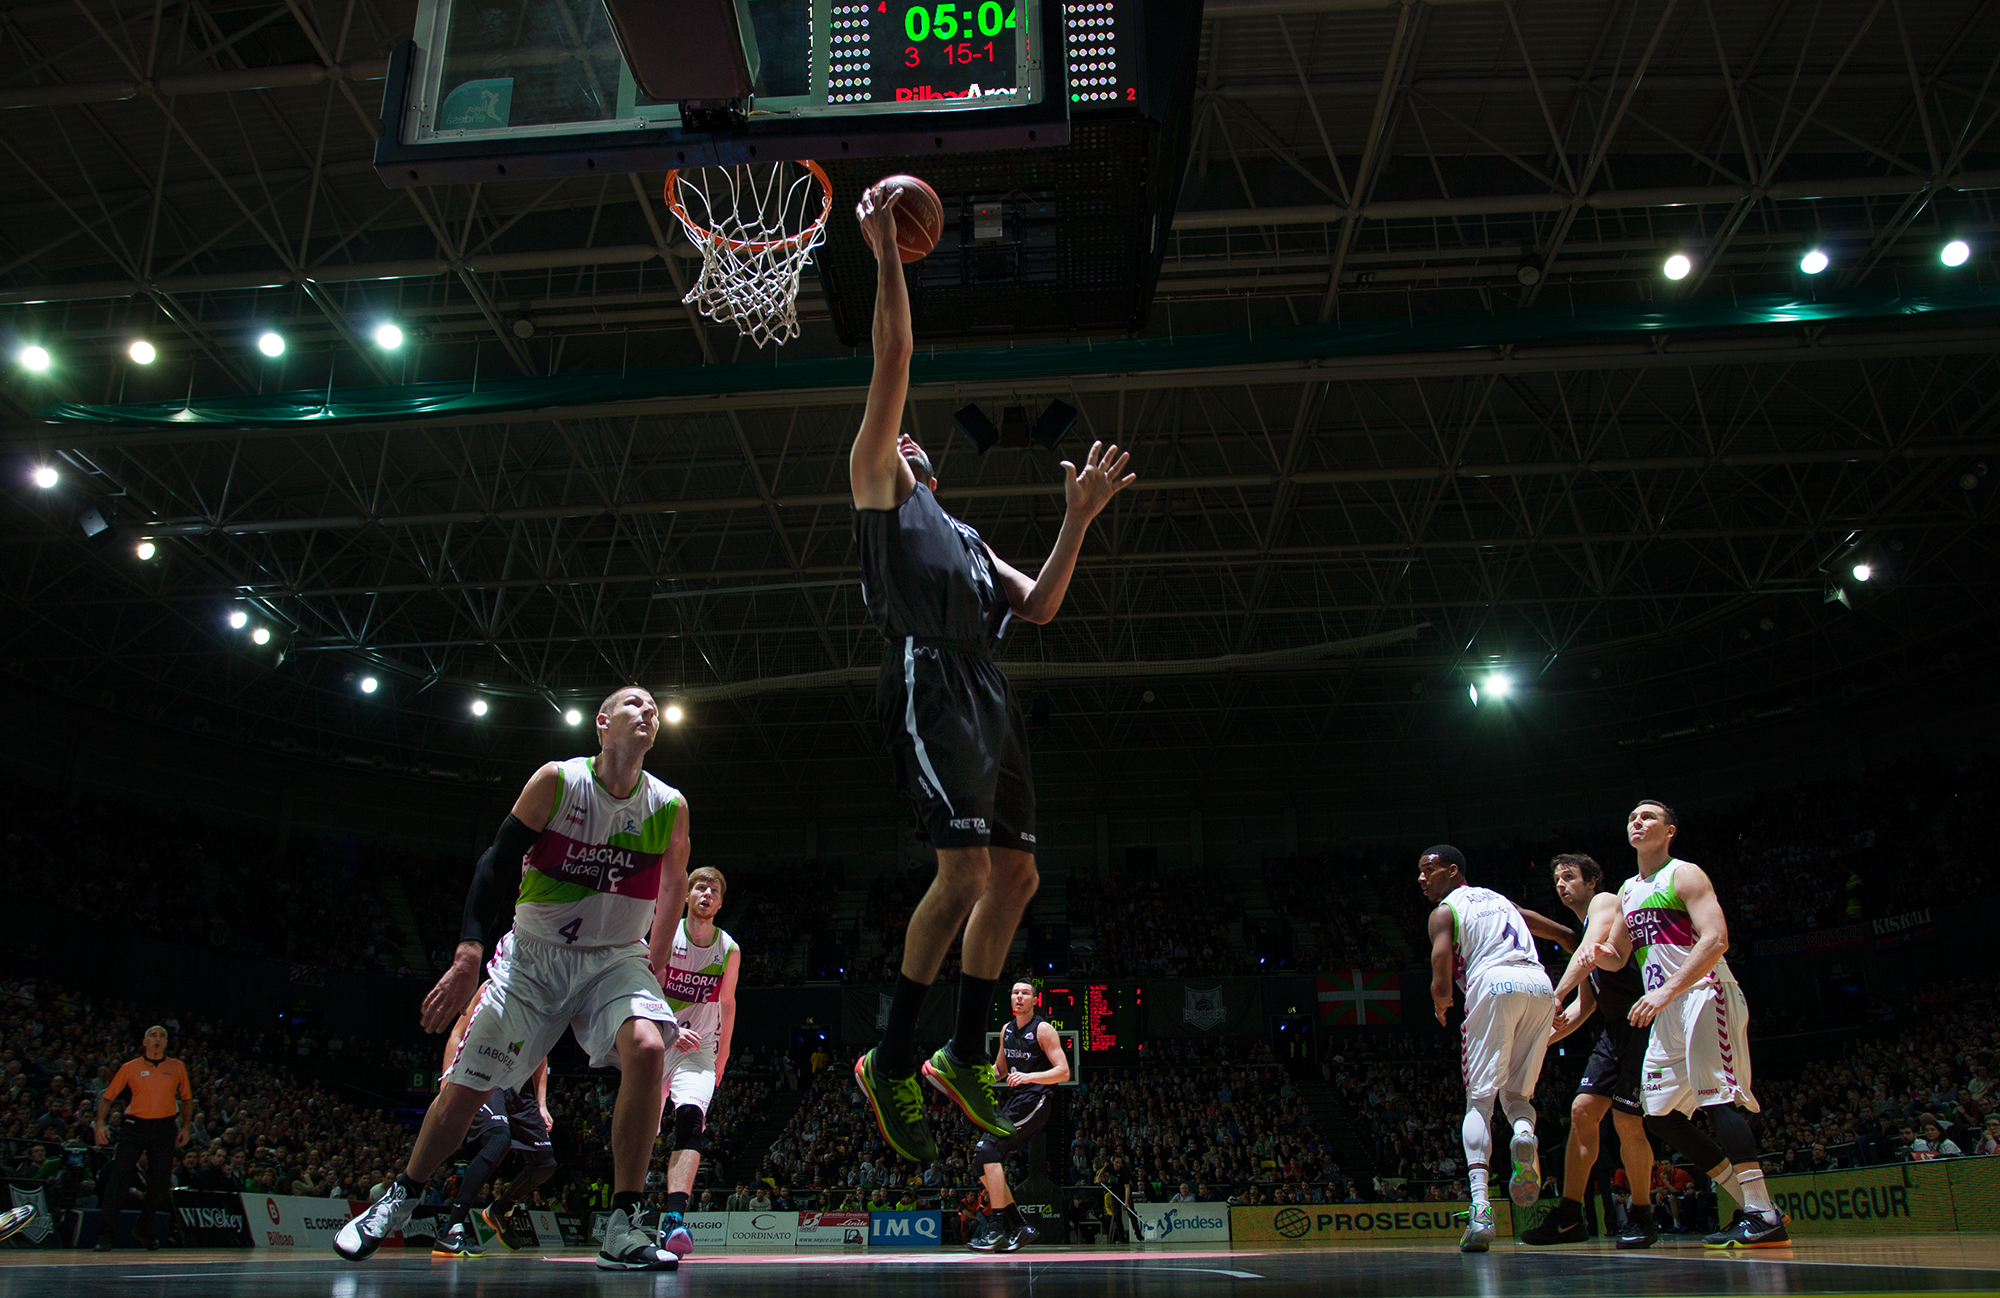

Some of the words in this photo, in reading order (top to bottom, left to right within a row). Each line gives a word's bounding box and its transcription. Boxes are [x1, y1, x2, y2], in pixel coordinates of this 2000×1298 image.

[877, 1, 887, 13] 4
[904, 47, 920, 67] 3
[1126, 87, 1137, 101] 2
[949, 817, 987, 830] RETA
[566, 842, 635, 869] LABORAL
[561, 859, 600, 877] kutxa
[1626, 911, 1662, 928] BORAL
[1872, 906, 1933, 936] KISKALI
[558, 917, 583, 945] 4
[1753, 935, 1804, 957] INDAR
[668, 969, 718, 988] LABORAL
[1645, 963, 1666, 991] 23
[665, 980, 695, 996] kutxa
[478, 1044, 515, 1071] LABORAL
[414, 1073, 424, 1087] B
[1017, 1203, 1053, 1217] RETA
[1774, 1185, 1911, 1221] PROSEGUR
[303, 1217, 316, 1230] EL
[872, 1217, 938, 1239] IMQ
[1173, 1215, 1224, 1229] endesa
[1317, 1209, 1471, 1232] PROSEGUR
[267, 1231, 294, 1246] Bilbao
[732, 1231, 791, 1240] COORDINATO
